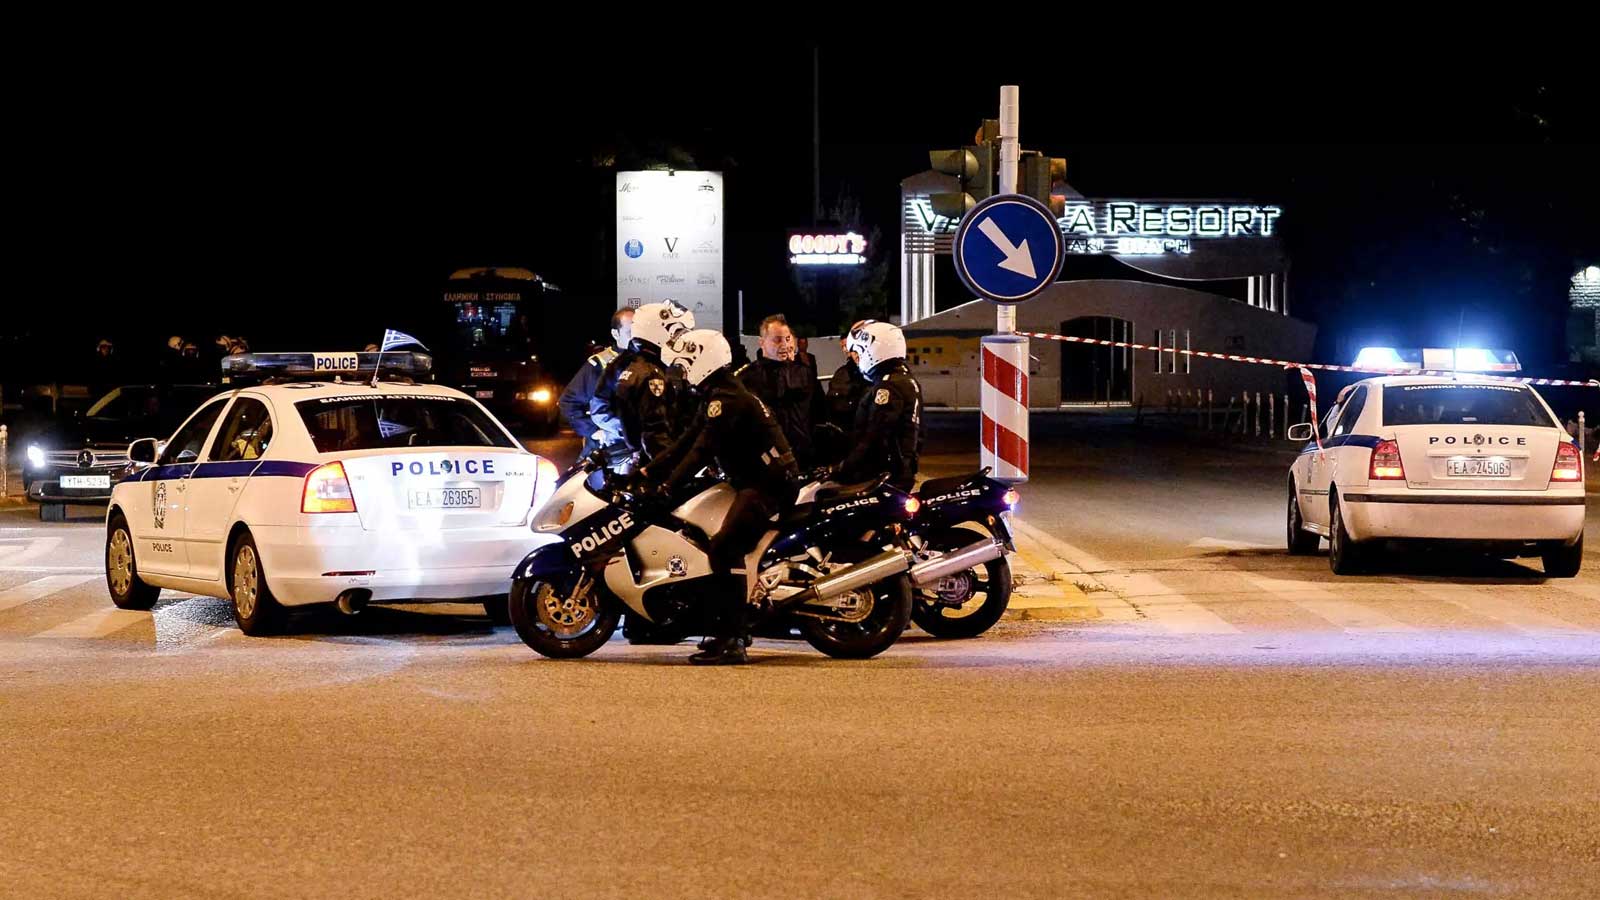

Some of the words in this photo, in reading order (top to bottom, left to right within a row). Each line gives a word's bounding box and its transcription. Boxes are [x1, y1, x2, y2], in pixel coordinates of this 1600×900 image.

[1108, 203, 1280, 235] RESORT
[664, 237, 680, 253] V
[789, 232, 867, 254] GOODY'S
[316, 357, 357, 370] POLICE
[1429, 436, 1527, 446] POLICE
[391, 460, 495, 476] POLICE
[1476, 462, 1506, 475] 24506
[442, 490, 475, 506] 26365
[826, 496, 880, 514] POLICE
[926, 489, 981, 505] POLICE
[571, 512, 635, 559] POLICE
[152, 542, 173, 553] POLICE
